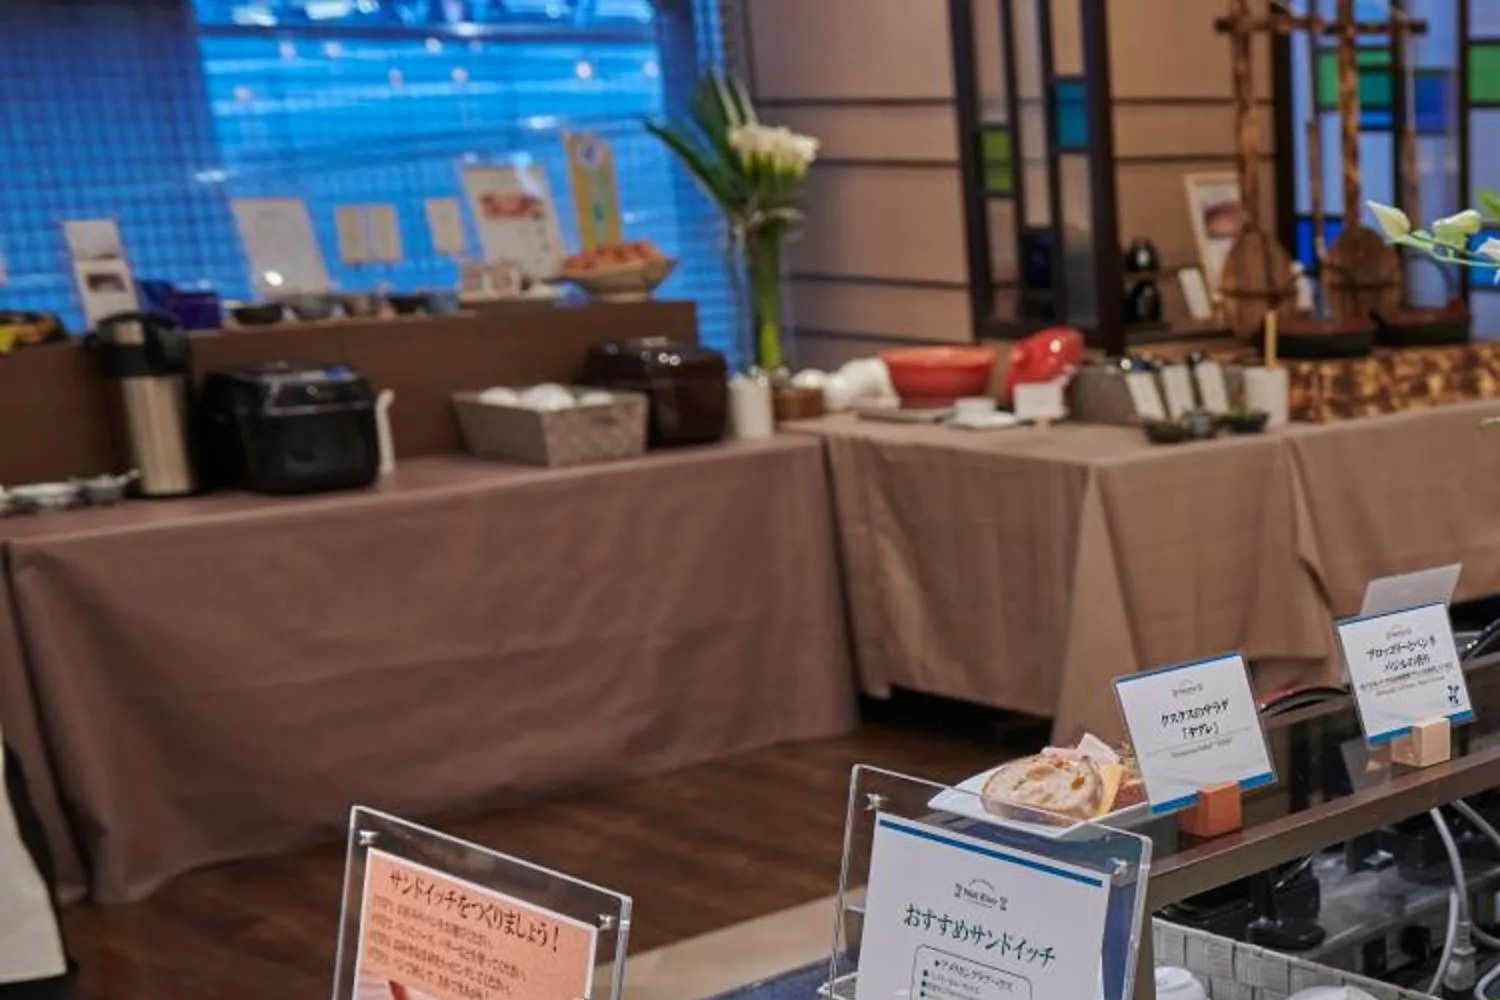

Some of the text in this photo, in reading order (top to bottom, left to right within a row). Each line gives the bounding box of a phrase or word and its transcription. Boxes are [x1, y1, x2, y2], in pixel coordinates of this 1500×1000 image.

[904, 903, 1057, 967] おすすめサンドイッチ
